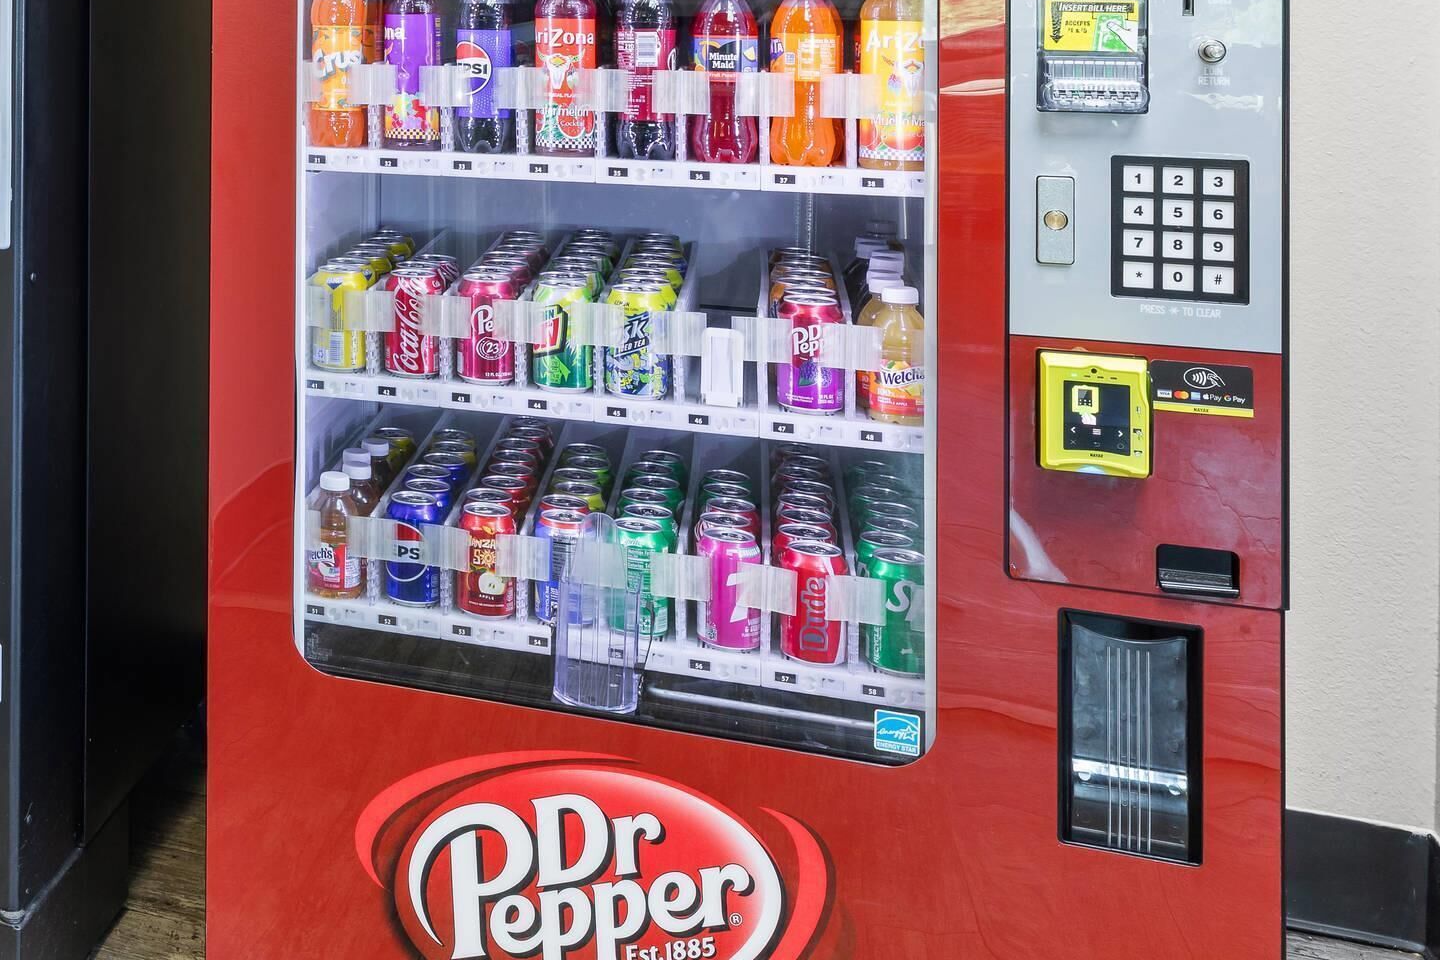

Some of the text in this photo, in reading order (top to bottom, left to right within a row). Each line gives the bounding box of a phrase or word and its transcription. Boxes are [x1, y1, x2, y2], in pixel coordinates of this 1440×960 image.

[1058, 2, 1128, 13] INSERT BILL HERE
[536, 28, 595, 48] riZona
[865, 29, 925, 53] AriZ
[709, 52, 738, 61] Minute
[712, 60, 735, 69] Maid
[1134, 173, 1141, 184] 1
[1173, 175, 1183, 186] 2
[1213, 176, 1223, 187] 3
[1134, 205, 1143, 216] 4
[1173, 207, 1183, 218] 5
[1213, 209, 1223, 220] 6
[1134, 237, 1143, 248] 7
[1173, 239, 1183, 250] 8
[1213, 241, 1223, 252] 9
[1173, 271, 1183, 282] 0
[1139, 304, 1222, 318] PRESS TO CLEAR
[486, 342, 499, 354] 23
[1209, 393, 1246, 404] Pay Pay
[478, 593, 495, 601] APPLE
[873, 626, 881, 663] RECYCLE
[876, 741, 917, 754] ENERGY STAR
[530, 793, 662, 888] Dr
[408, 802, 751, 960] Pepper
